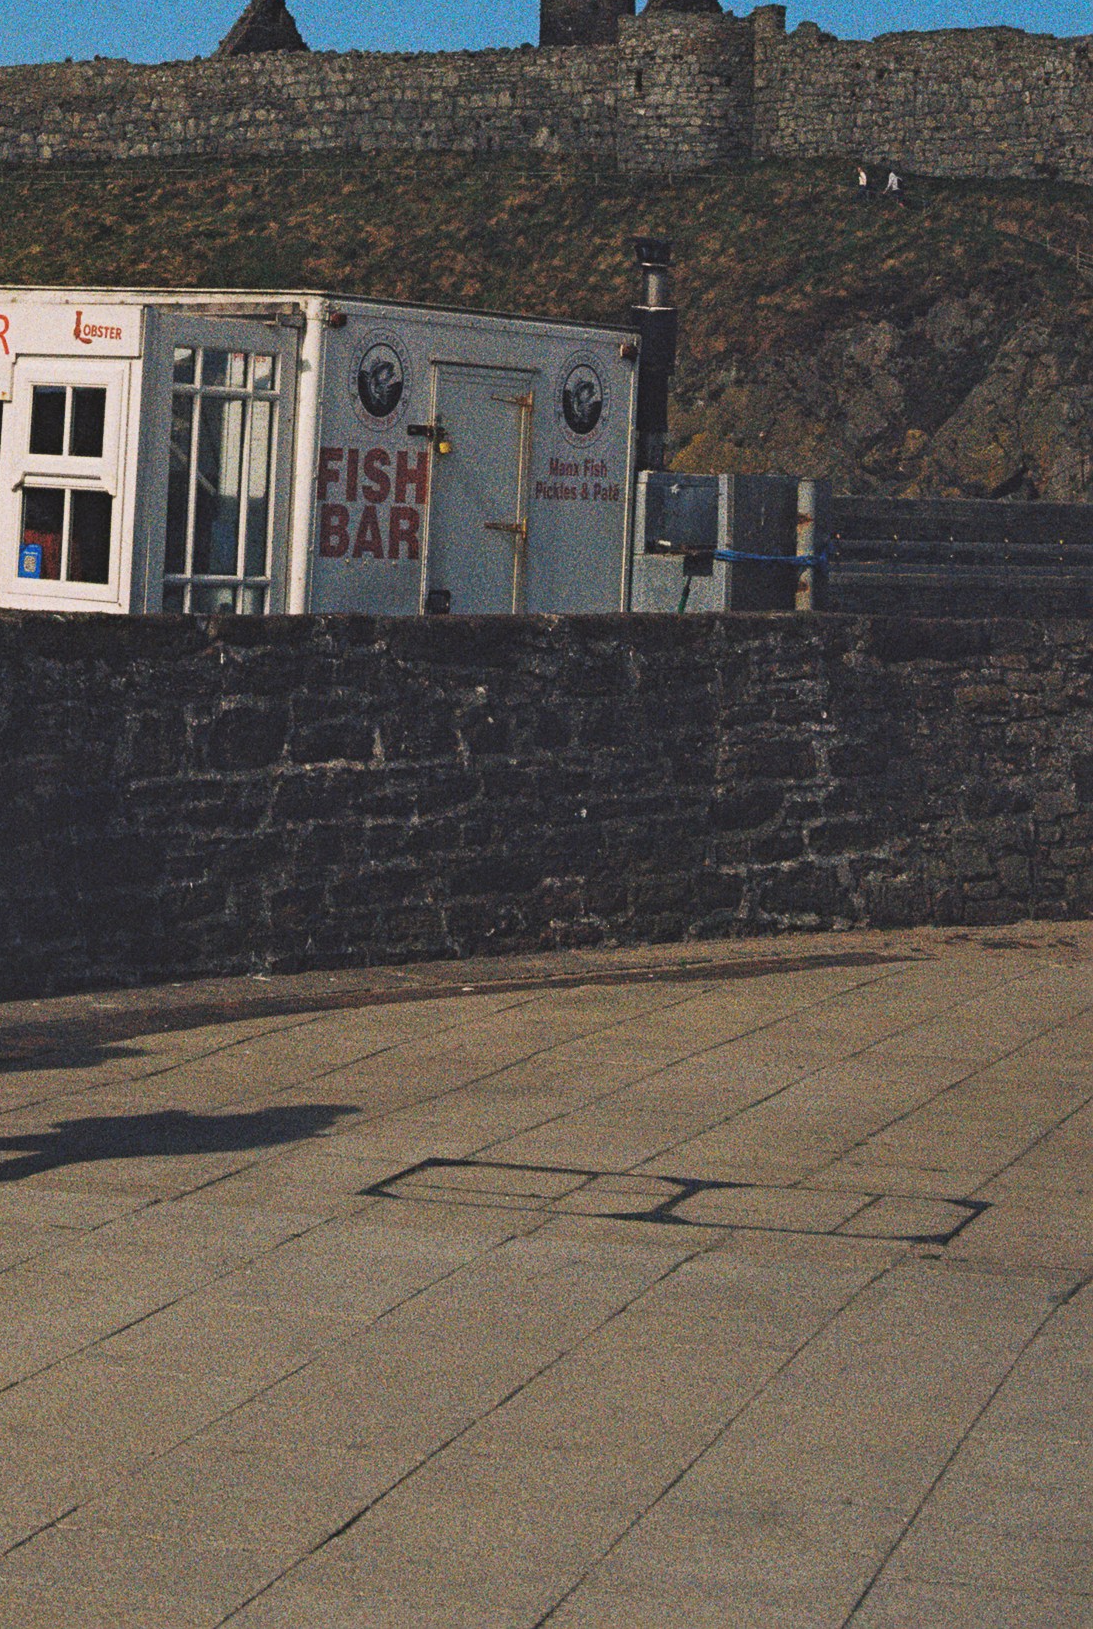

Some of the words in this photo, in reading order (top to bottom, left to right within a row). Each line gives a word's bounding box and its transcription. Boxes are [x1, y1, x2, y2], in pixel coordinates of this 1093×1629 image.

[73, 310, 122, 344] LOBSTER
[317, 448, 428, 504] FISH
[549, 457, 579, 476] Manx
[583, 458, 607, 477] Fish
[535, 481, 576, 500] Pickles
[319, 503, 420, 560] BAR
